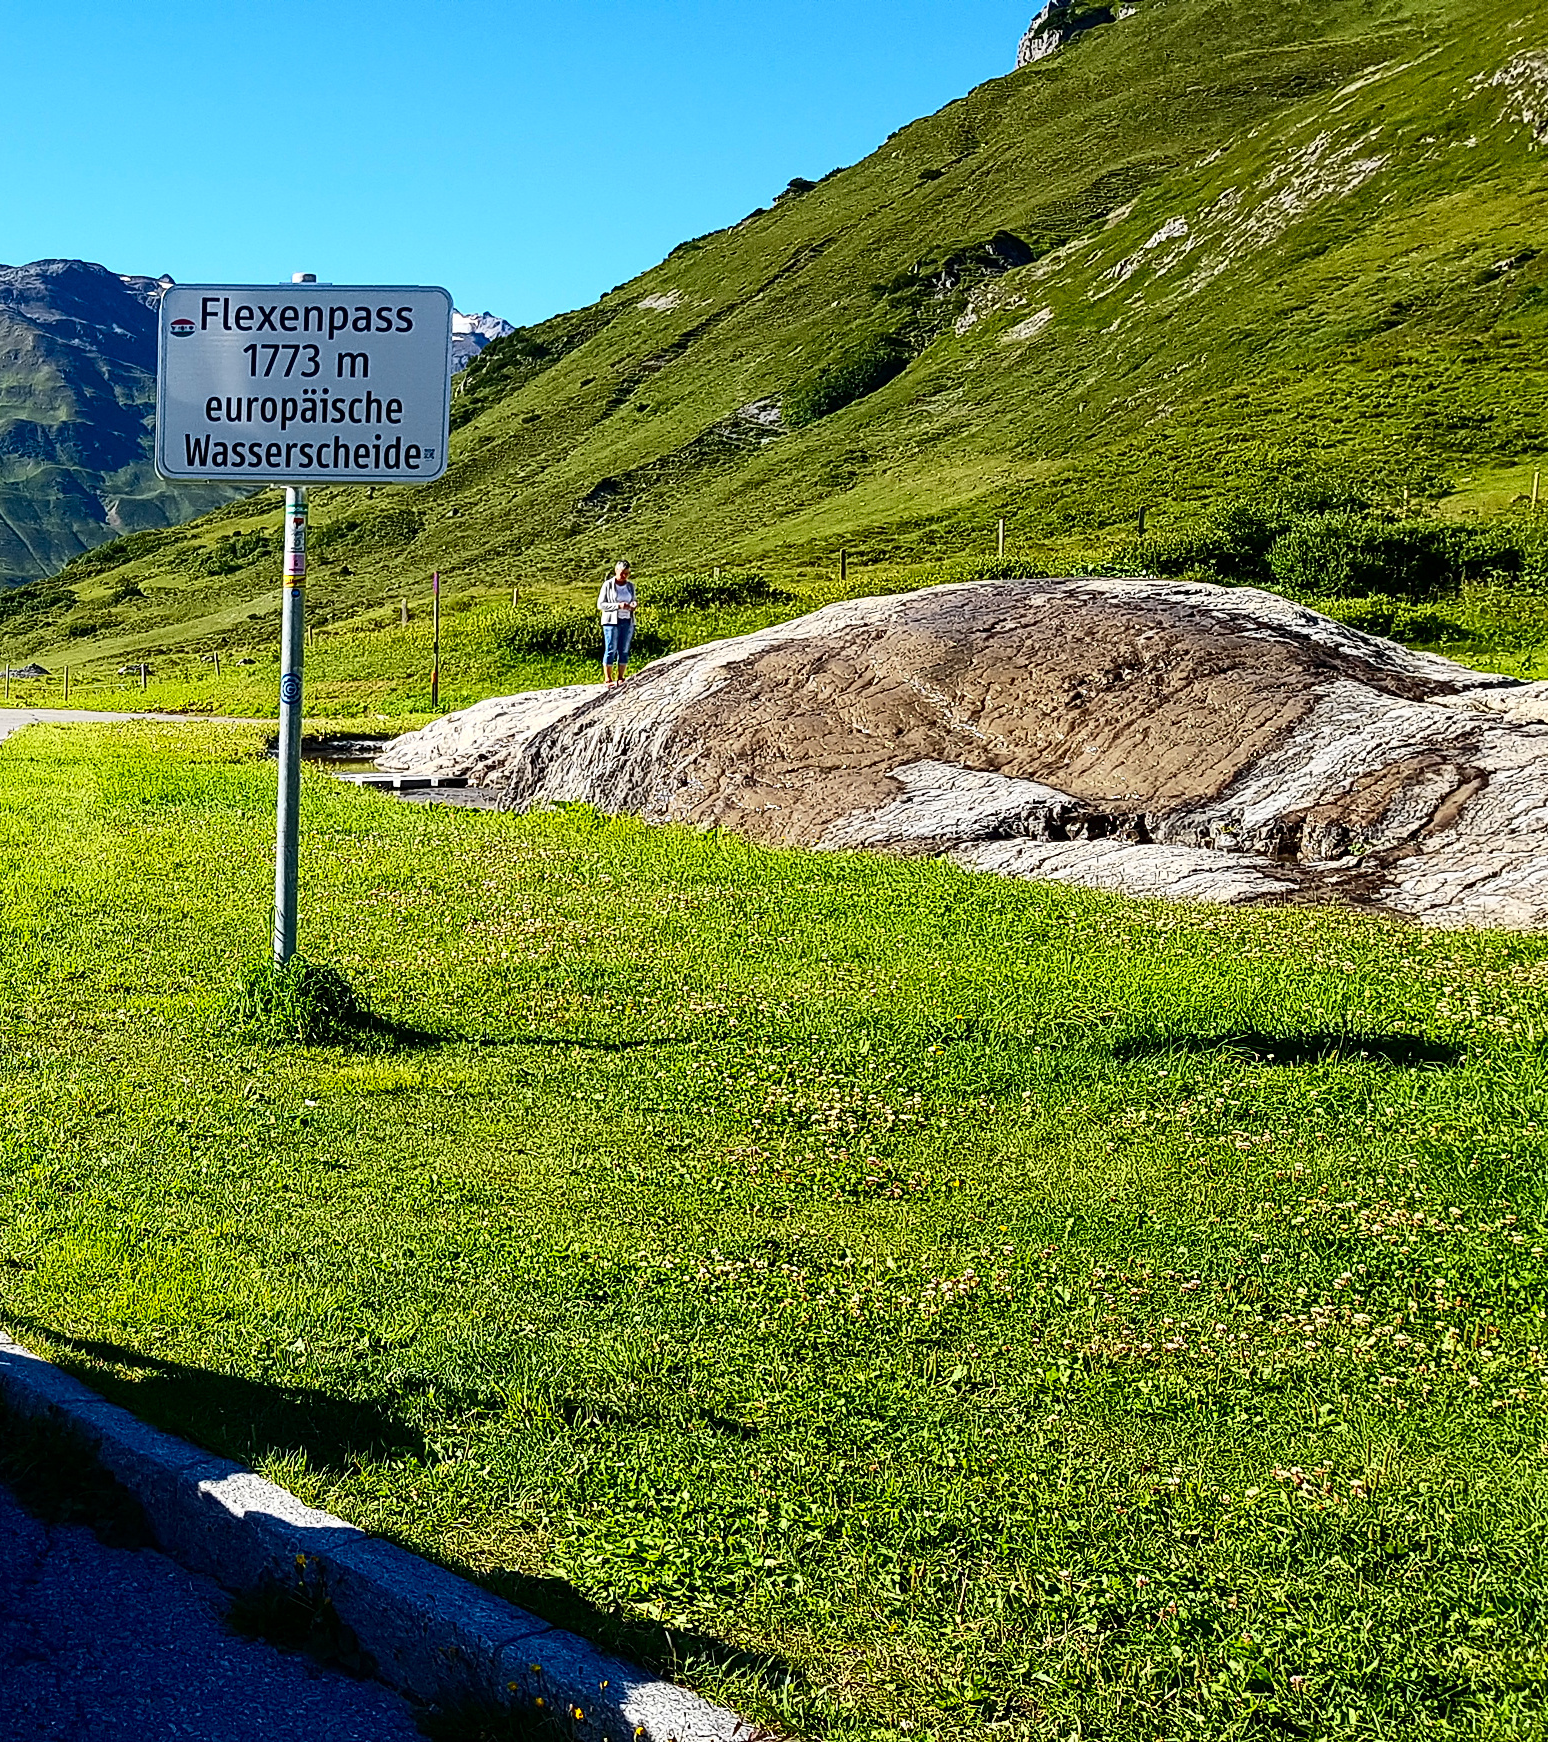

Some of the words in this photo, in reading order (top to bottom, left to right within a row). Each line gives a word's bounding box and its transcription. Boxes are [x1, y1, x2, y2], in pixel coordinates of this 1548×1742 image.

[200, 296, 414, 341] Flexenpass
[242, 343, 321, 378] 1773
[336, 350, 369, 379] m
[205, 387, 403, 431] europäische
[184, 433, 421, 470] Wasserscheide
